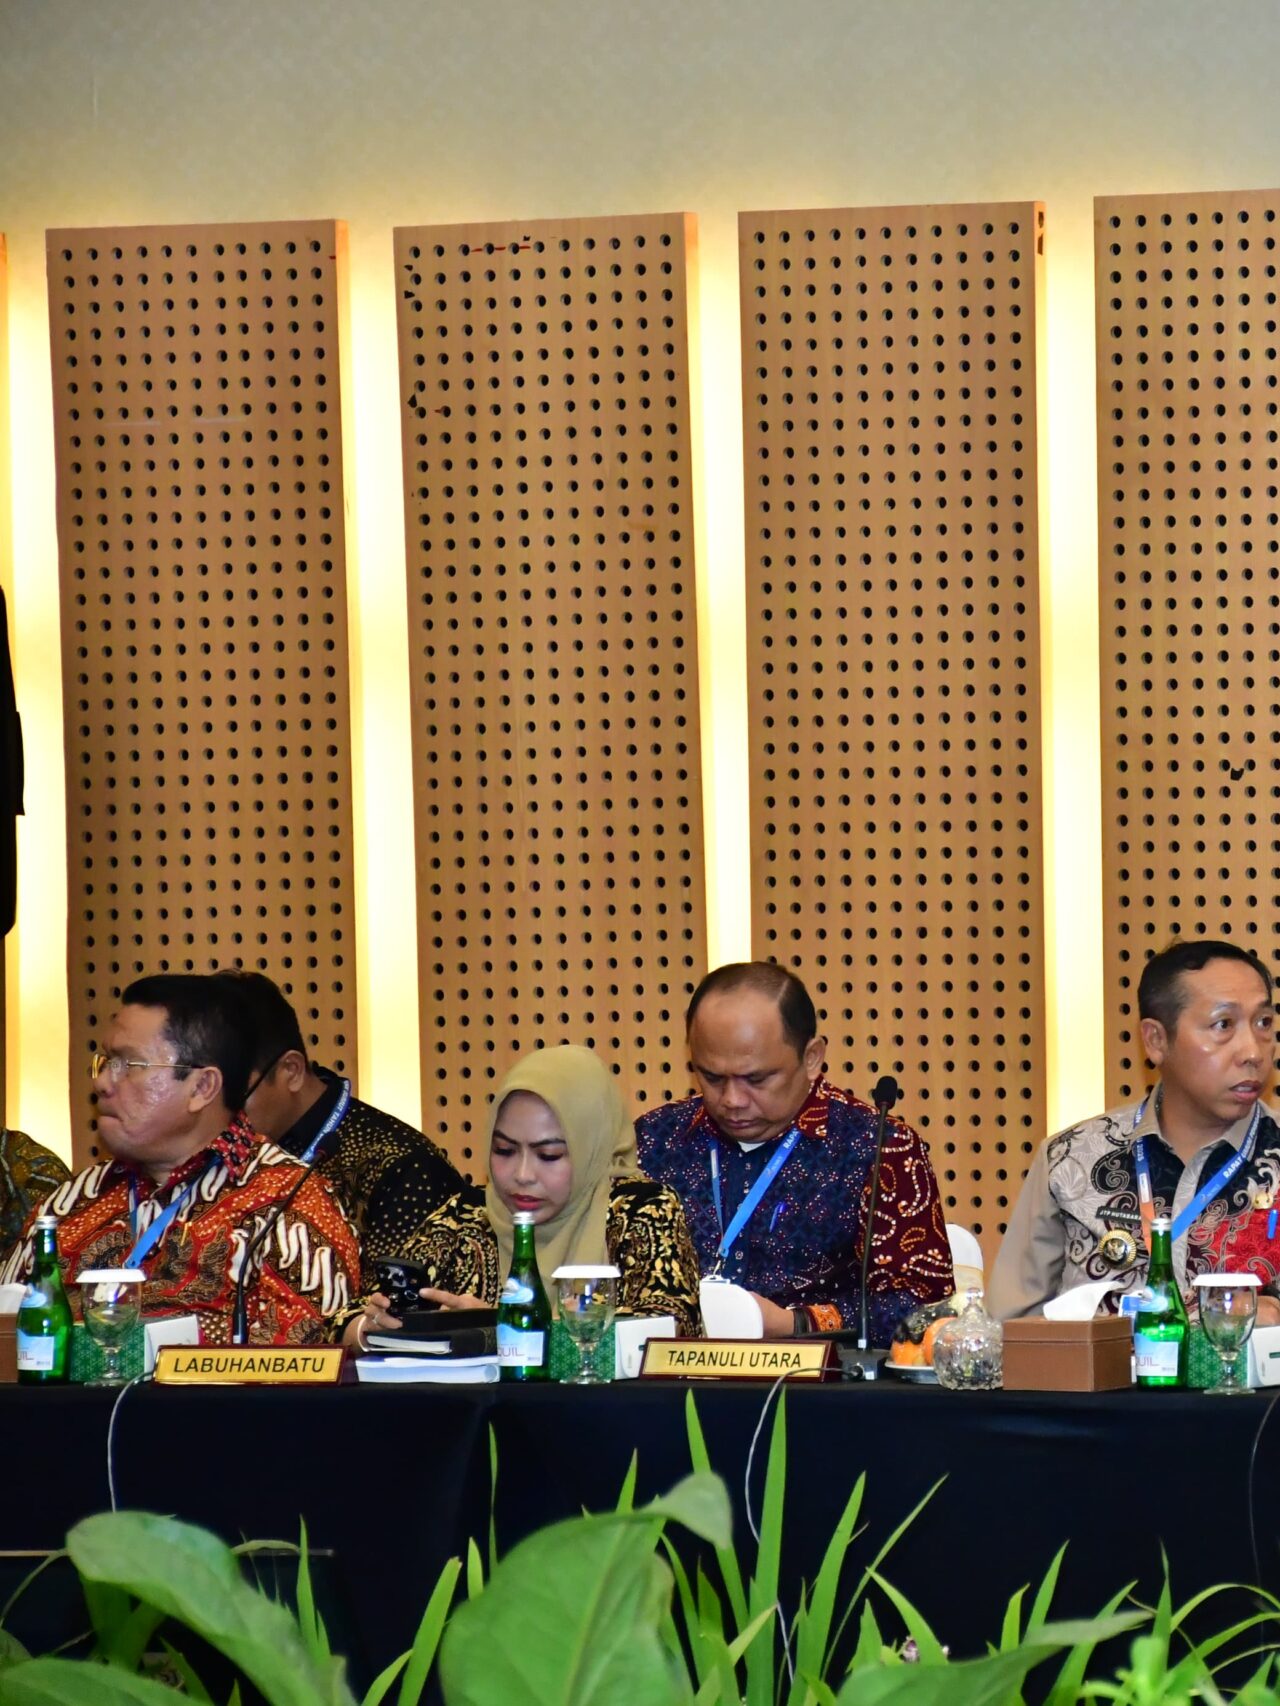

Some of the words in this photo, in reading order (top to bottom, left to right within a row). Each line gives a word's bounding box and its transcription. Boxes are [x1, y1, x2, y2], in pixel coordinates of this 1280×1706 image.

[1223, 1156, 1244, 1178] RAPAT
[173, 1356, 326, 1374] LABUHANBATU
[667, 1349, 745, 1368] TAPANULI
[748, 1351, 803, 1369] UTARA
